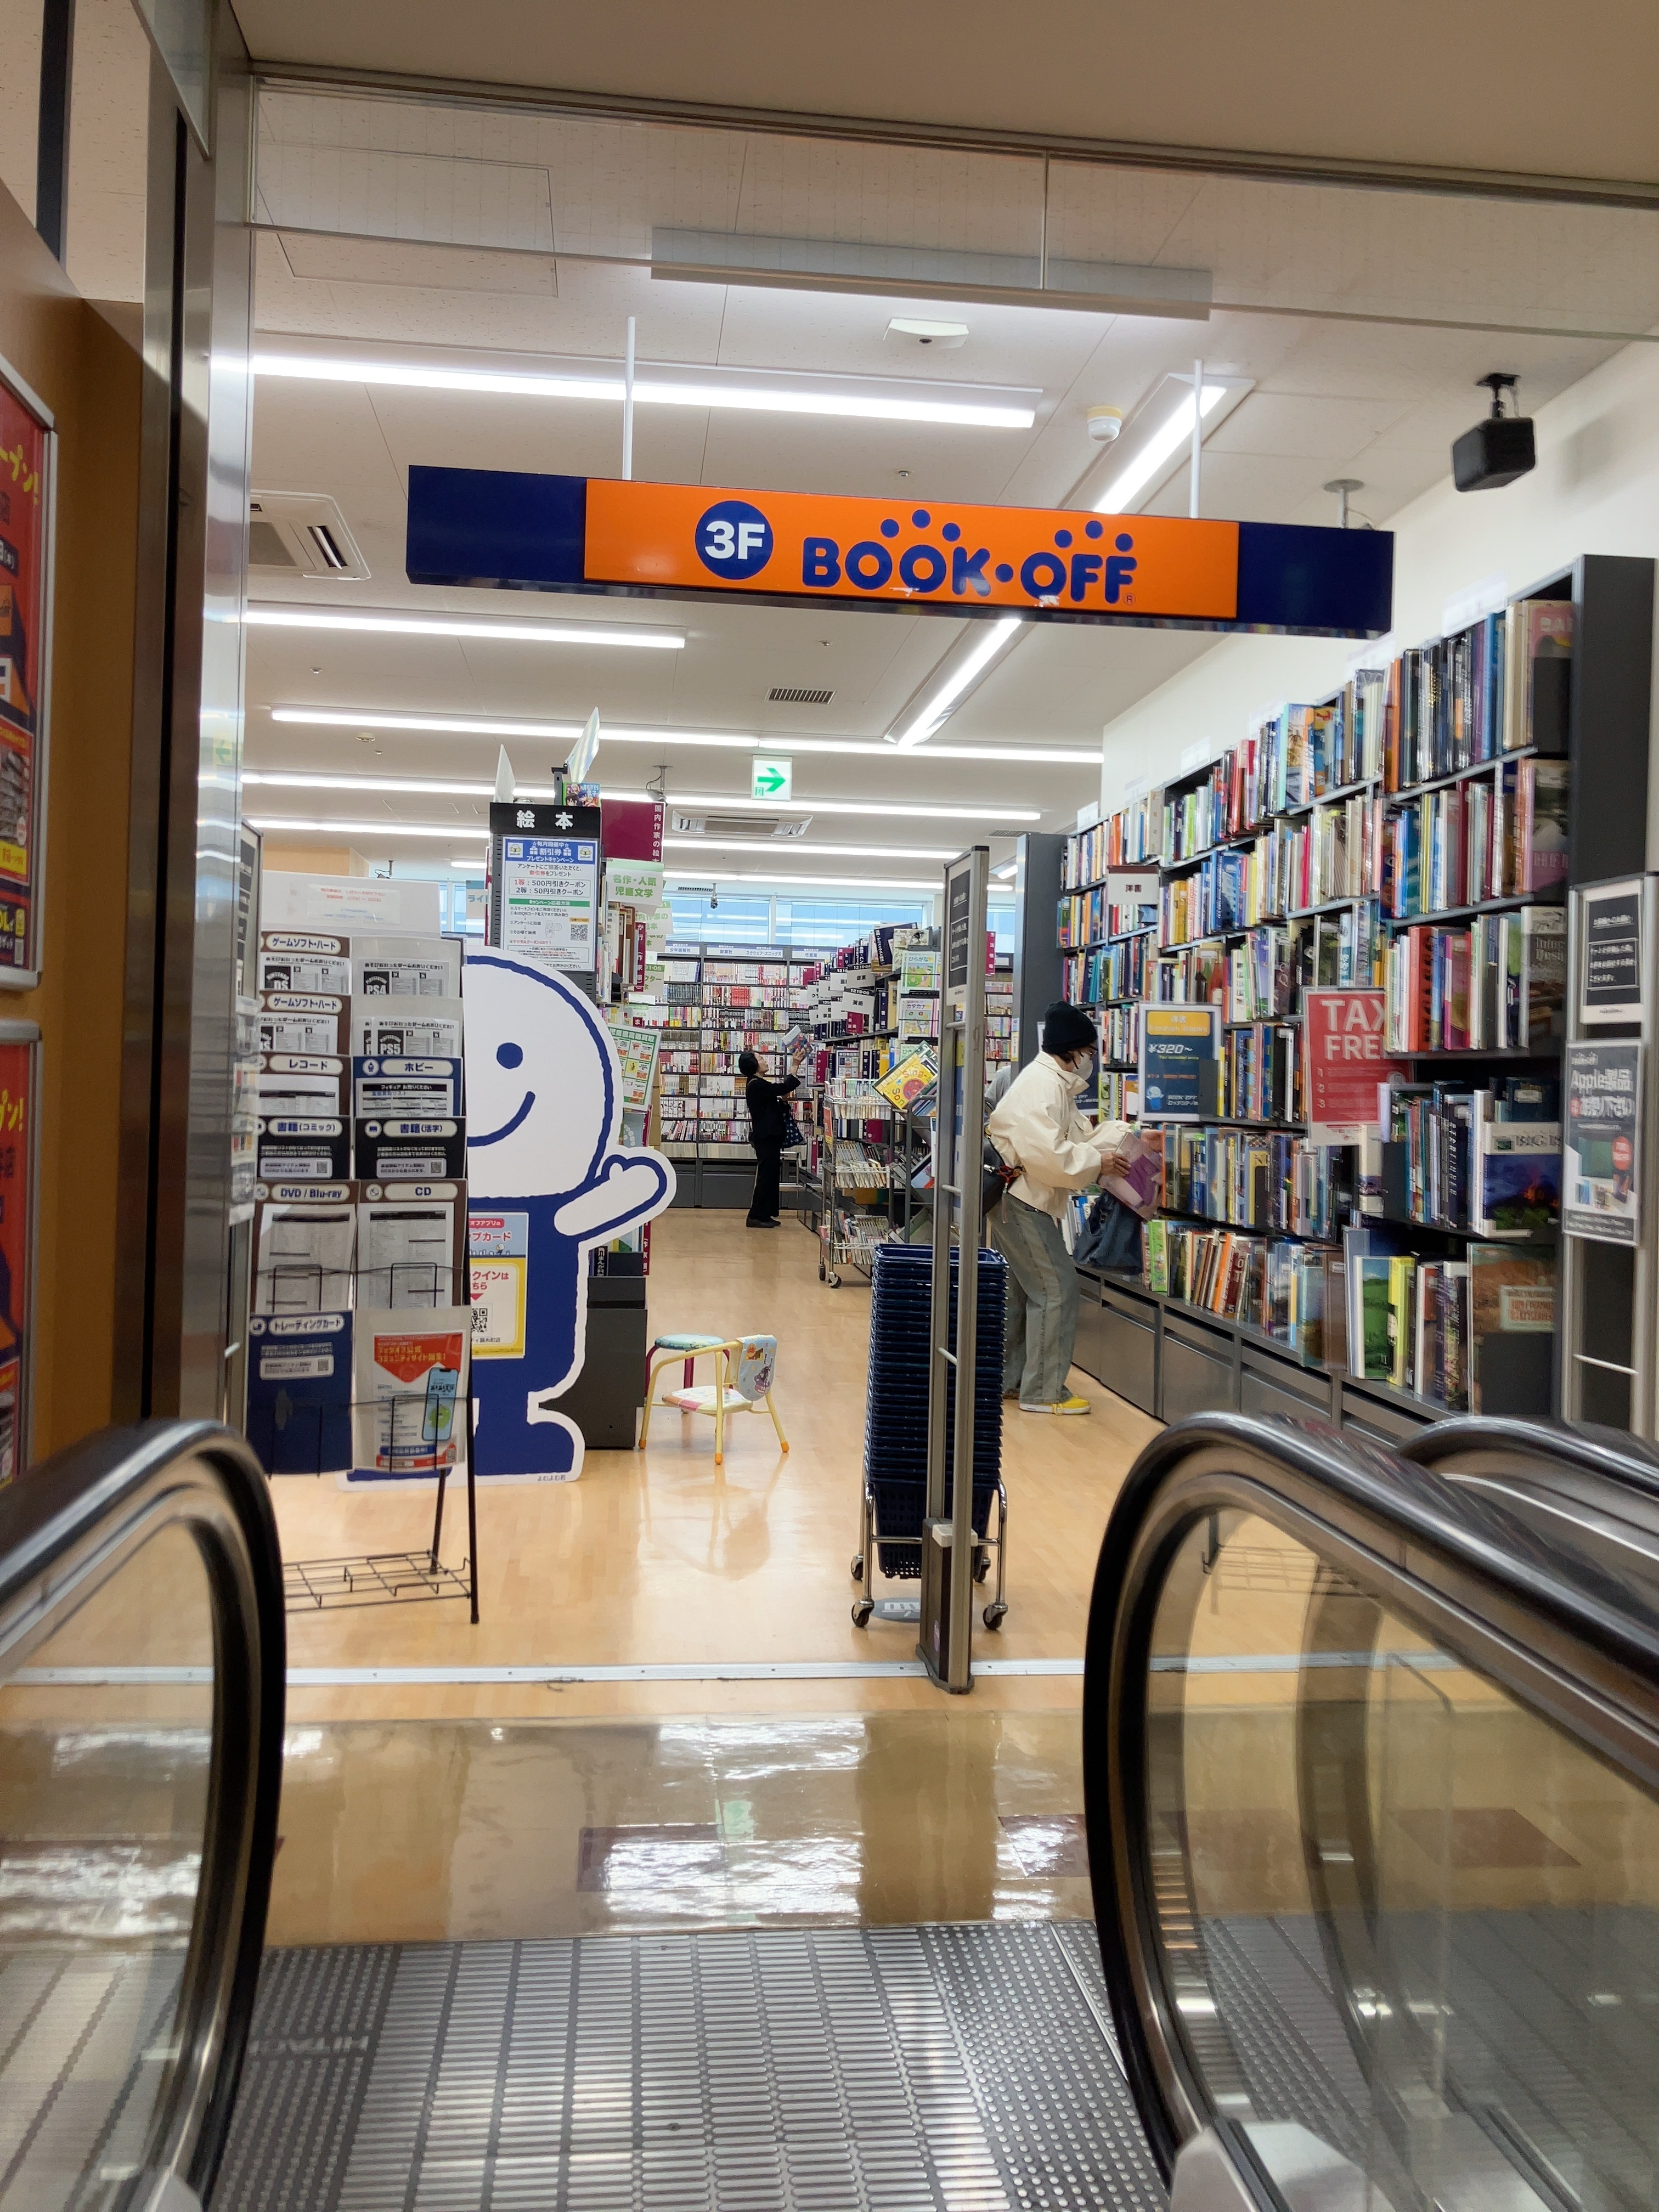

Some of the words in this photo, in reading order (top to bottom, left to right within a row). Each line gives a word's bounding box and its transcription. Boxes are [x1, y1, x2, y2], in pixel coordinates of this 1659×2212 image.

[704, 521, 766, 560] 3F
[516, 810, 573, 830] 絵本
[613, 874, 657, 887] 名作・人気
[616, 886, 653, 898] 児童文学
[272, 936, 336, 951] ゲームソフト・ハード
[366, 984, 387, 995] PS4
[274, 996, 337, 1010] ゲームソフト・ハード
[1321, 999, 1385, 1032] TAX
[380, 1043, 402, 1054] PS5
[1325, 1034, 1386, 1060] FRE
[289, 1058, 328, 1070] レコード
[404, 1062, 434, 1071] ホビー
[280, 1187, 302, 1197] DVD
[309, 1188, 342, 1199] Blu-ray
[415, 1186, 432, 1196] CD
[469, 1232, 511, 1242] プカード
[273, 1314, 342, 1331] トレーディングカード
